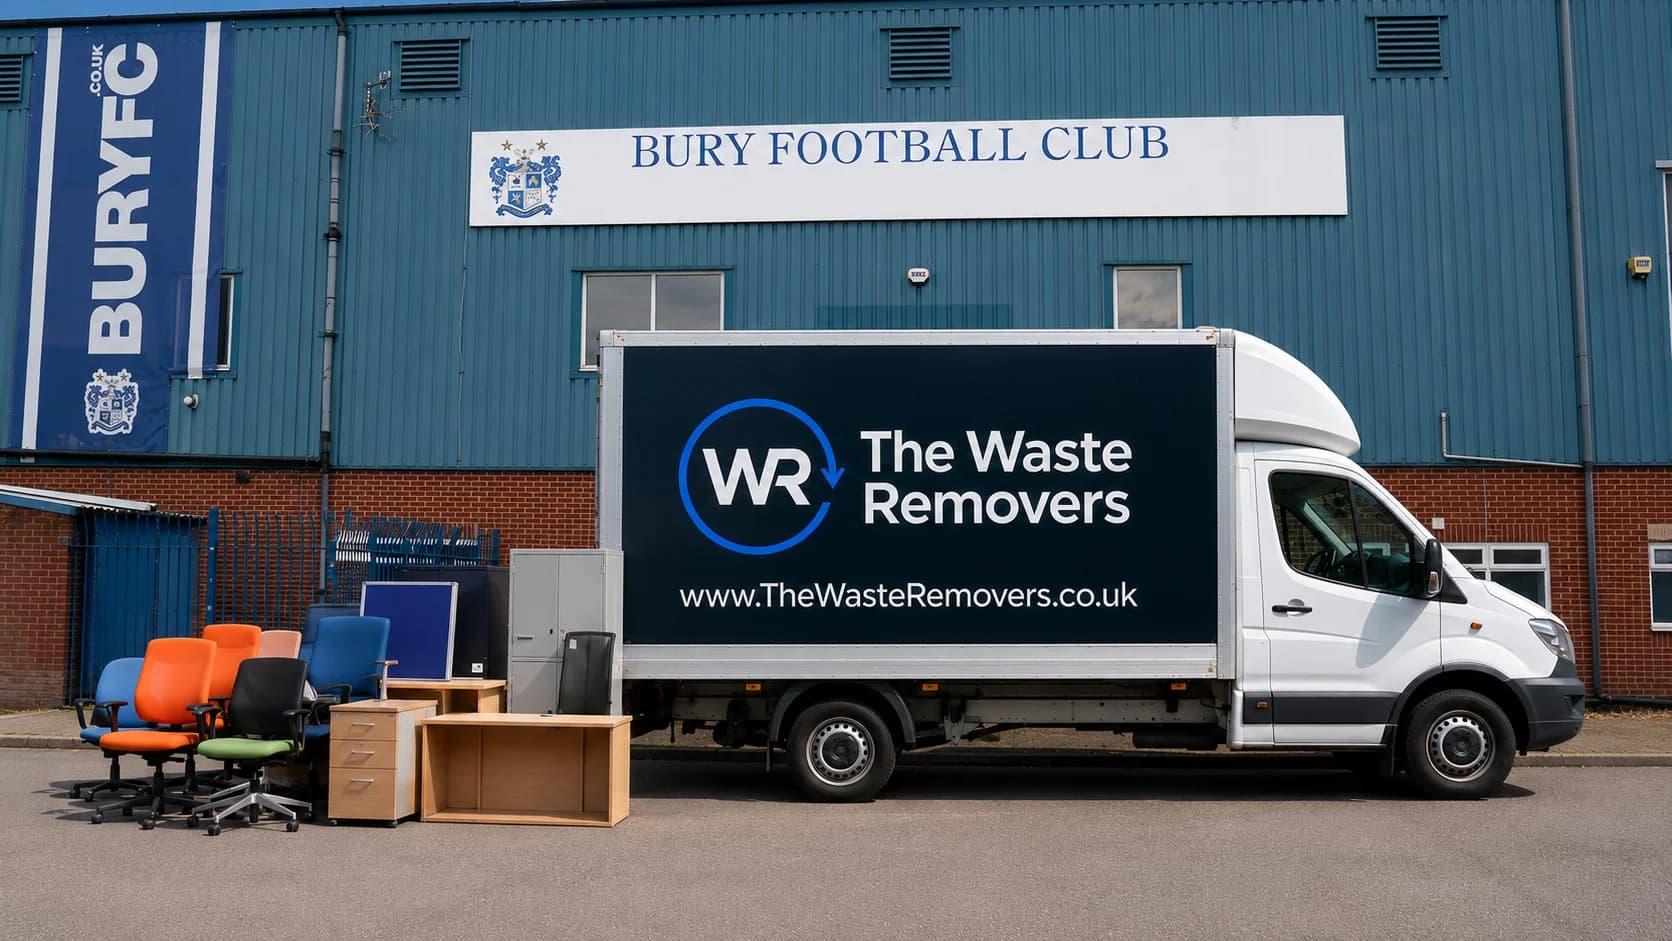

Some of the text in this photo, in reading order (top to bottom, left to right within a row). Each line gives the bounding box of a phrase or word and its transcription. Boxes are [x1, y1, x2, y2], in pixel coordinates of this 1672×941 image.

[90, 44, 104, 97] .CO.UK
[632, 126, 1170, 169] BURY FOOTBALL CLUB
[87, 42, 159, 355] BURYFC
[860, 429, 1133, 473] The Waste
[702, 447, 812, 506] WR
[864, 482, 1131, 525] Removers
[679, 581, 1139, 609] www.TheWasteRemovers.co.uk
